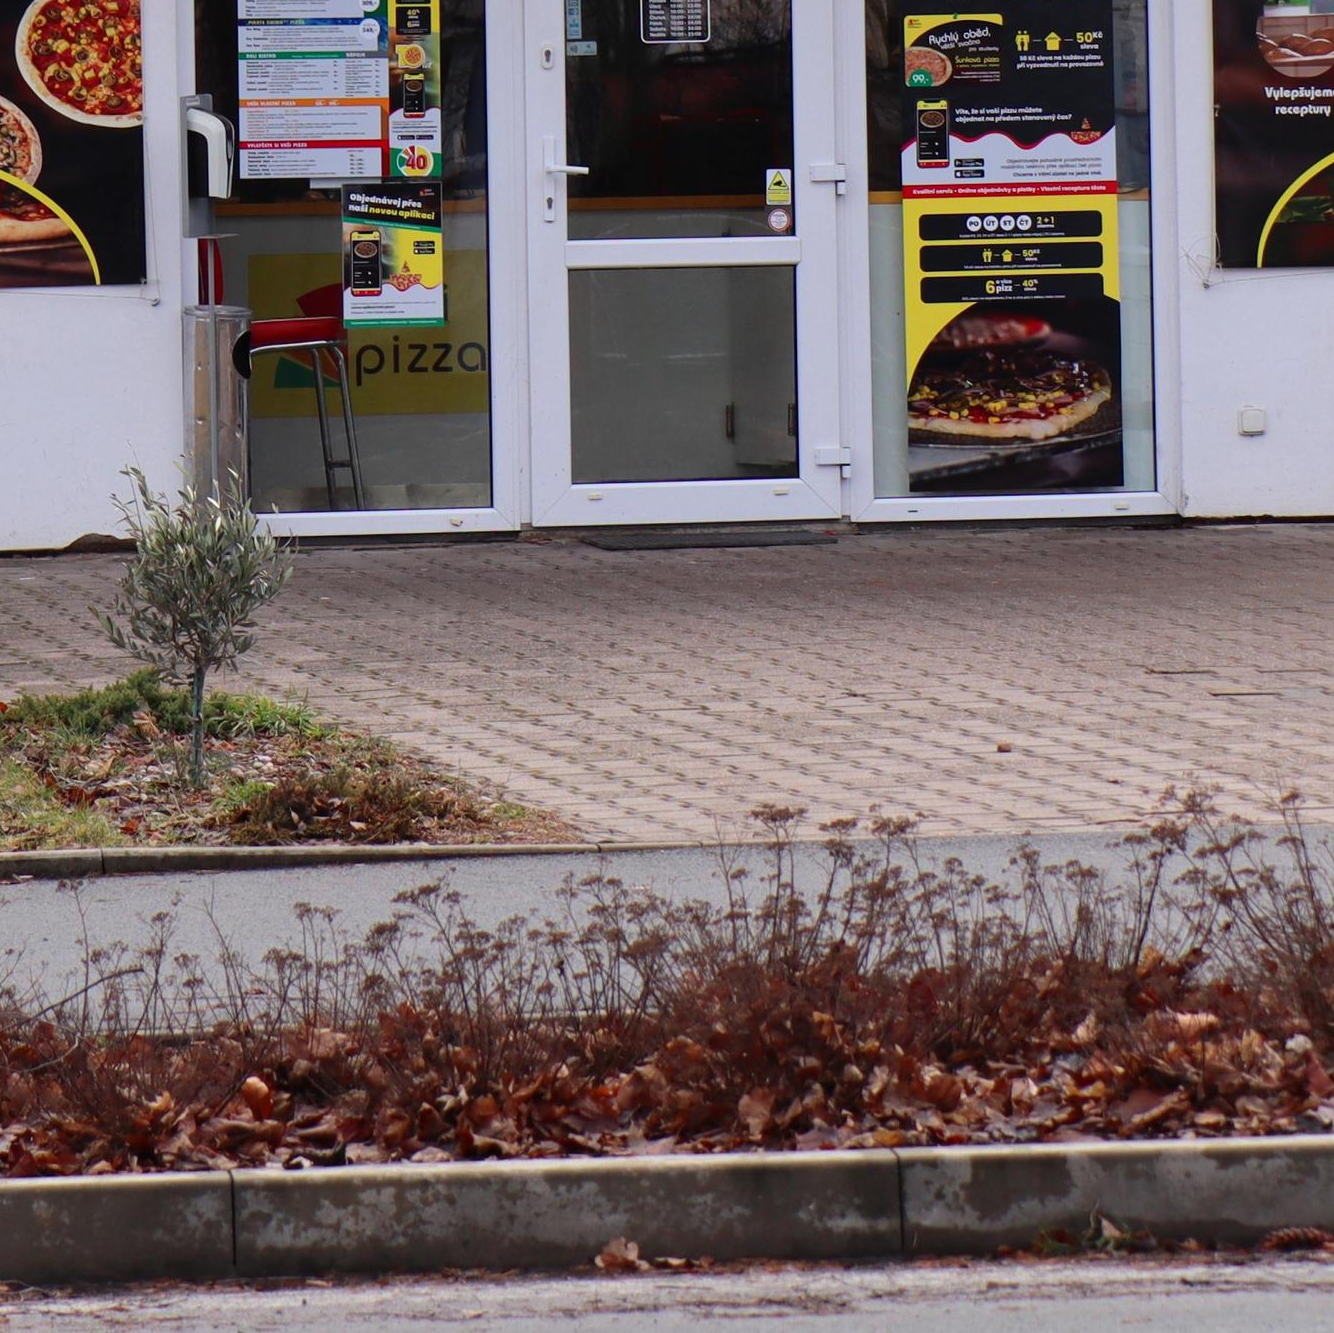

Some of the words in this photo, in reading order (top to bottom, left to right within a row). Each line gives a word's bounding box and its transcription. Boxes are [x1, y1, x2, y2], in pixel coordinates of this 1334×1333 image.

[929, 32, 959, 46] Rychlý
[964, 27, 991, 39] oběd,
[1275, 105, 1331, 117] receptury
[406, 155, 427, 169] 40
[350, 194, 401, 207] Objednávej
[402, 199, 422, 208] přes
[369, 207, 397, 216] novou
[399, 210, 435, 220] aplikaci
[986, 280, 995, 294] 6
[356, 335, 486, 387] pizza
